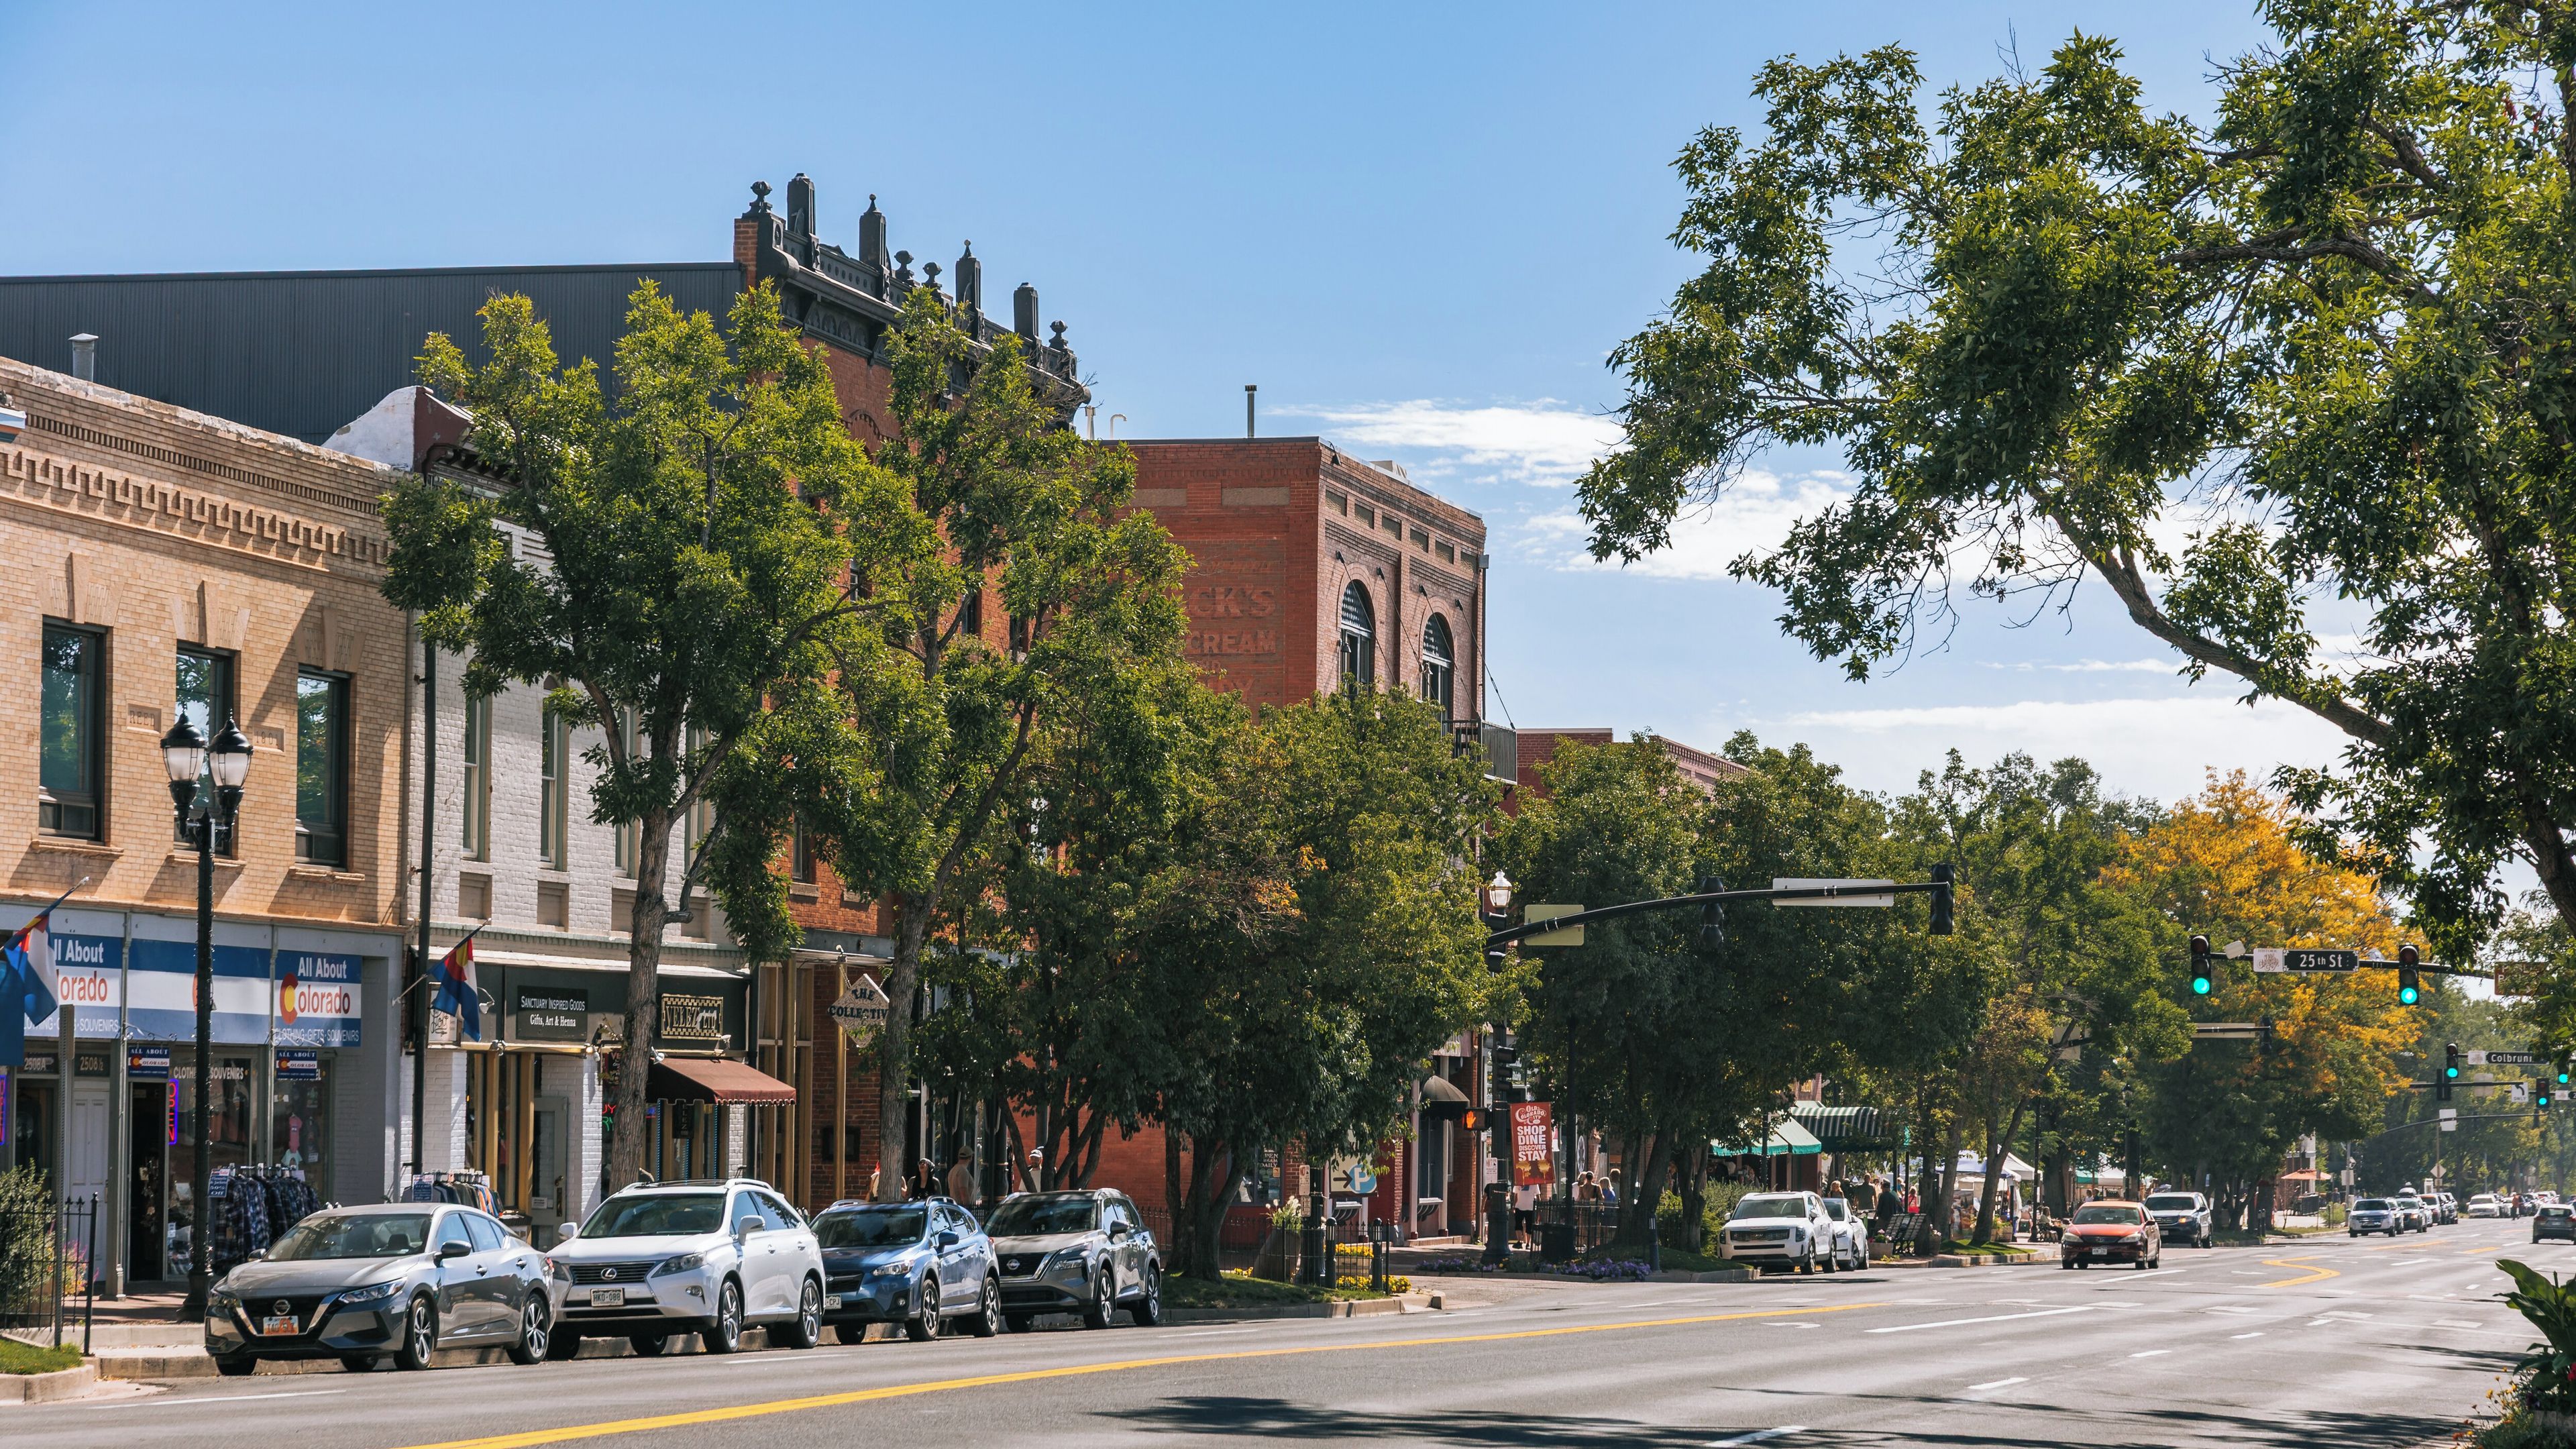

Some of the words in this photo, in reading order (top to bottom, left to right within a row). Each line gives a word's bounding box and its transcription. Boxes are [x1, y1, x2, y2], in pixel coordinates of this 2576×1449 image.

[129, 710, 155, 726] REED
[65, 940, 104, 963] About
[2329, 954, 2343, 967] St
[298, 957, 312, 977] All
[315, 958, 347, 979] About
[851, 987, 875, 1001] THE
[826, 1005, 888, 1019] COLLECTIV
[80, 1018, 119, 1032] SOUVENIRS
[530, 1014, 544, 1026] Gifts,
[545, 1016, 553, 1026] Art
[555, 1016, 559, 1026] &
[560, 1016, 576, 1026] Henna
[1517, 1125, 1546, 1136] SHOP
[1518, 1135, 1546, 1145] DINE
[1519, 1150, 1547, 1161] STAY
